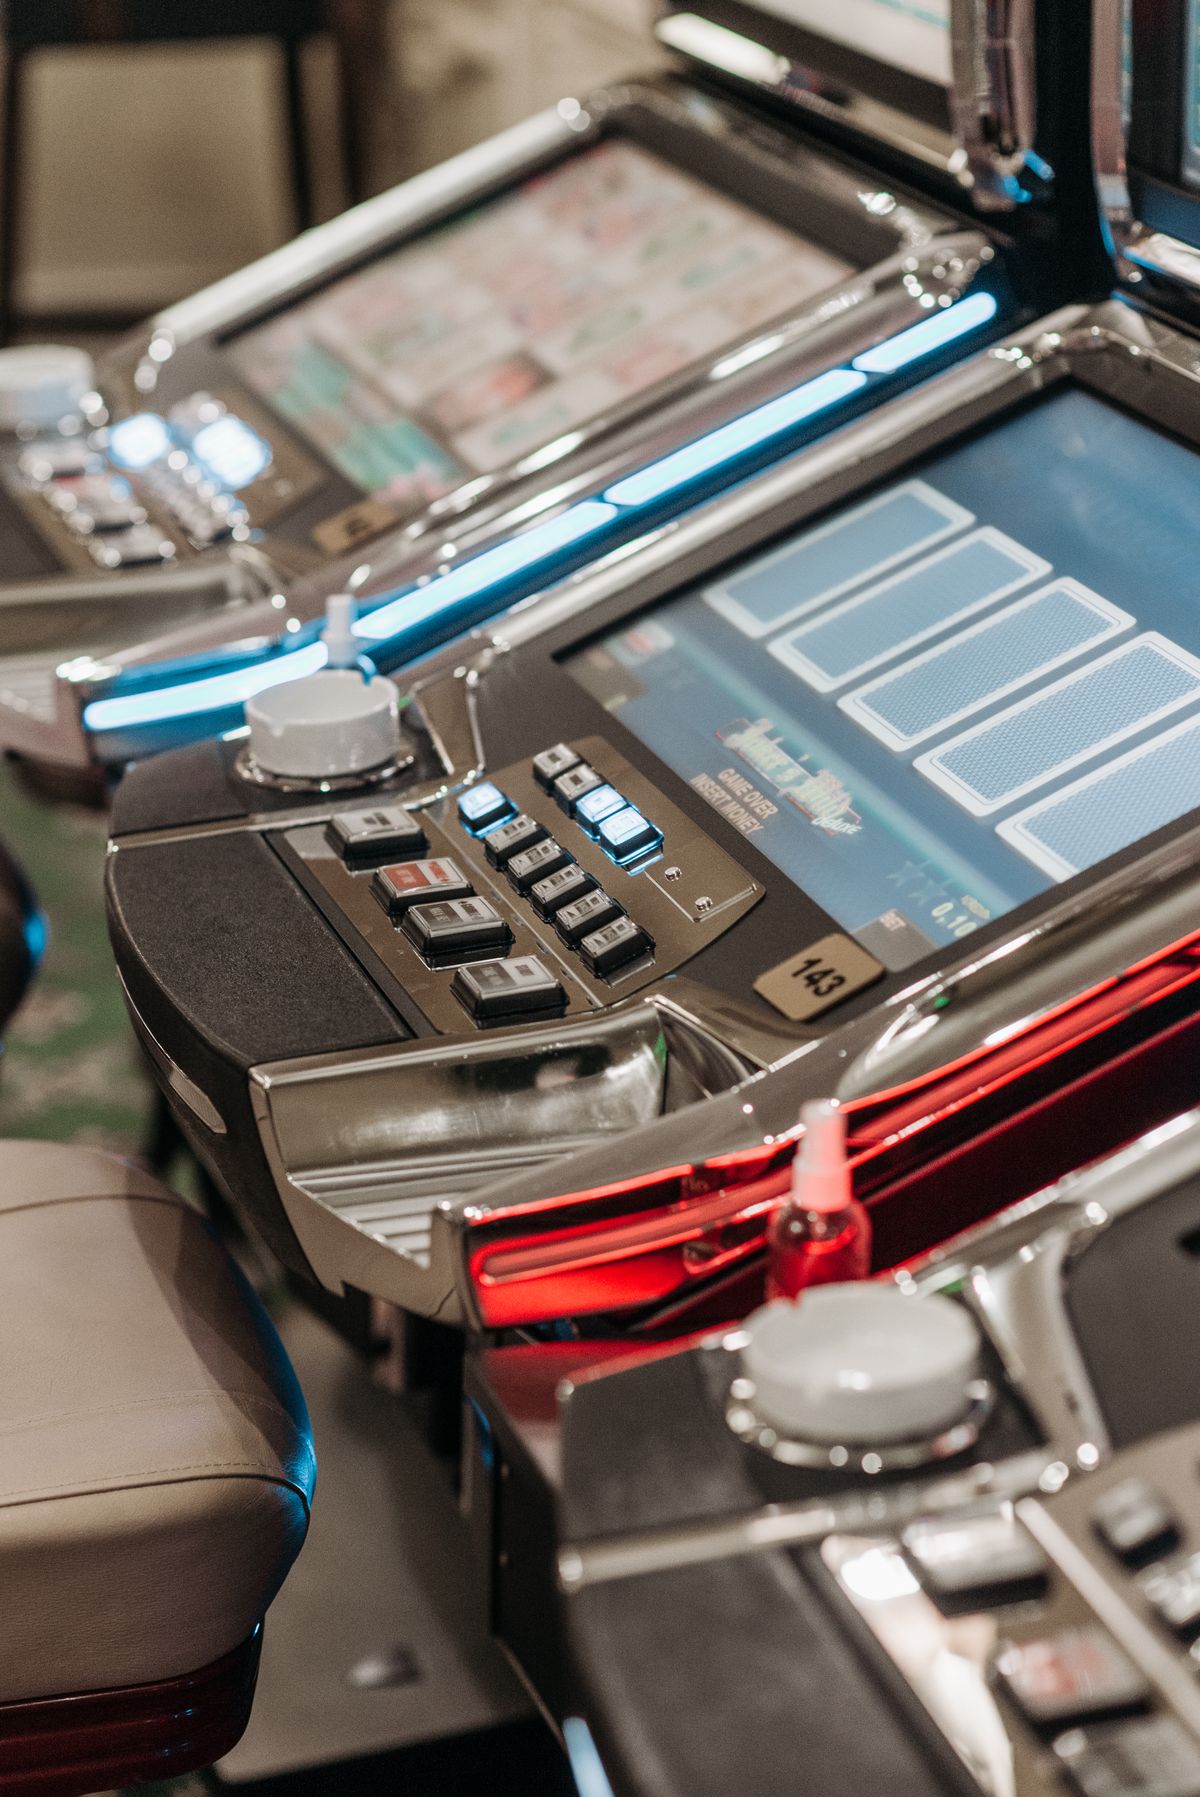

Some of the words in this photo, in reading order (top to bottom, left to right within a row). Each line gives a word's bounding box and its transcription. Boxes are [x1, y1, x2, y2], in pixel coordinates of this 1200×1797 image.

[690, 773, 732, 807] INSERT
[719, 801, 764, 834] MONEY
[718, 768, 751, 796] GAME
[746, 789, 778, 818] OVER
[792, 958, 847, 997] 143
